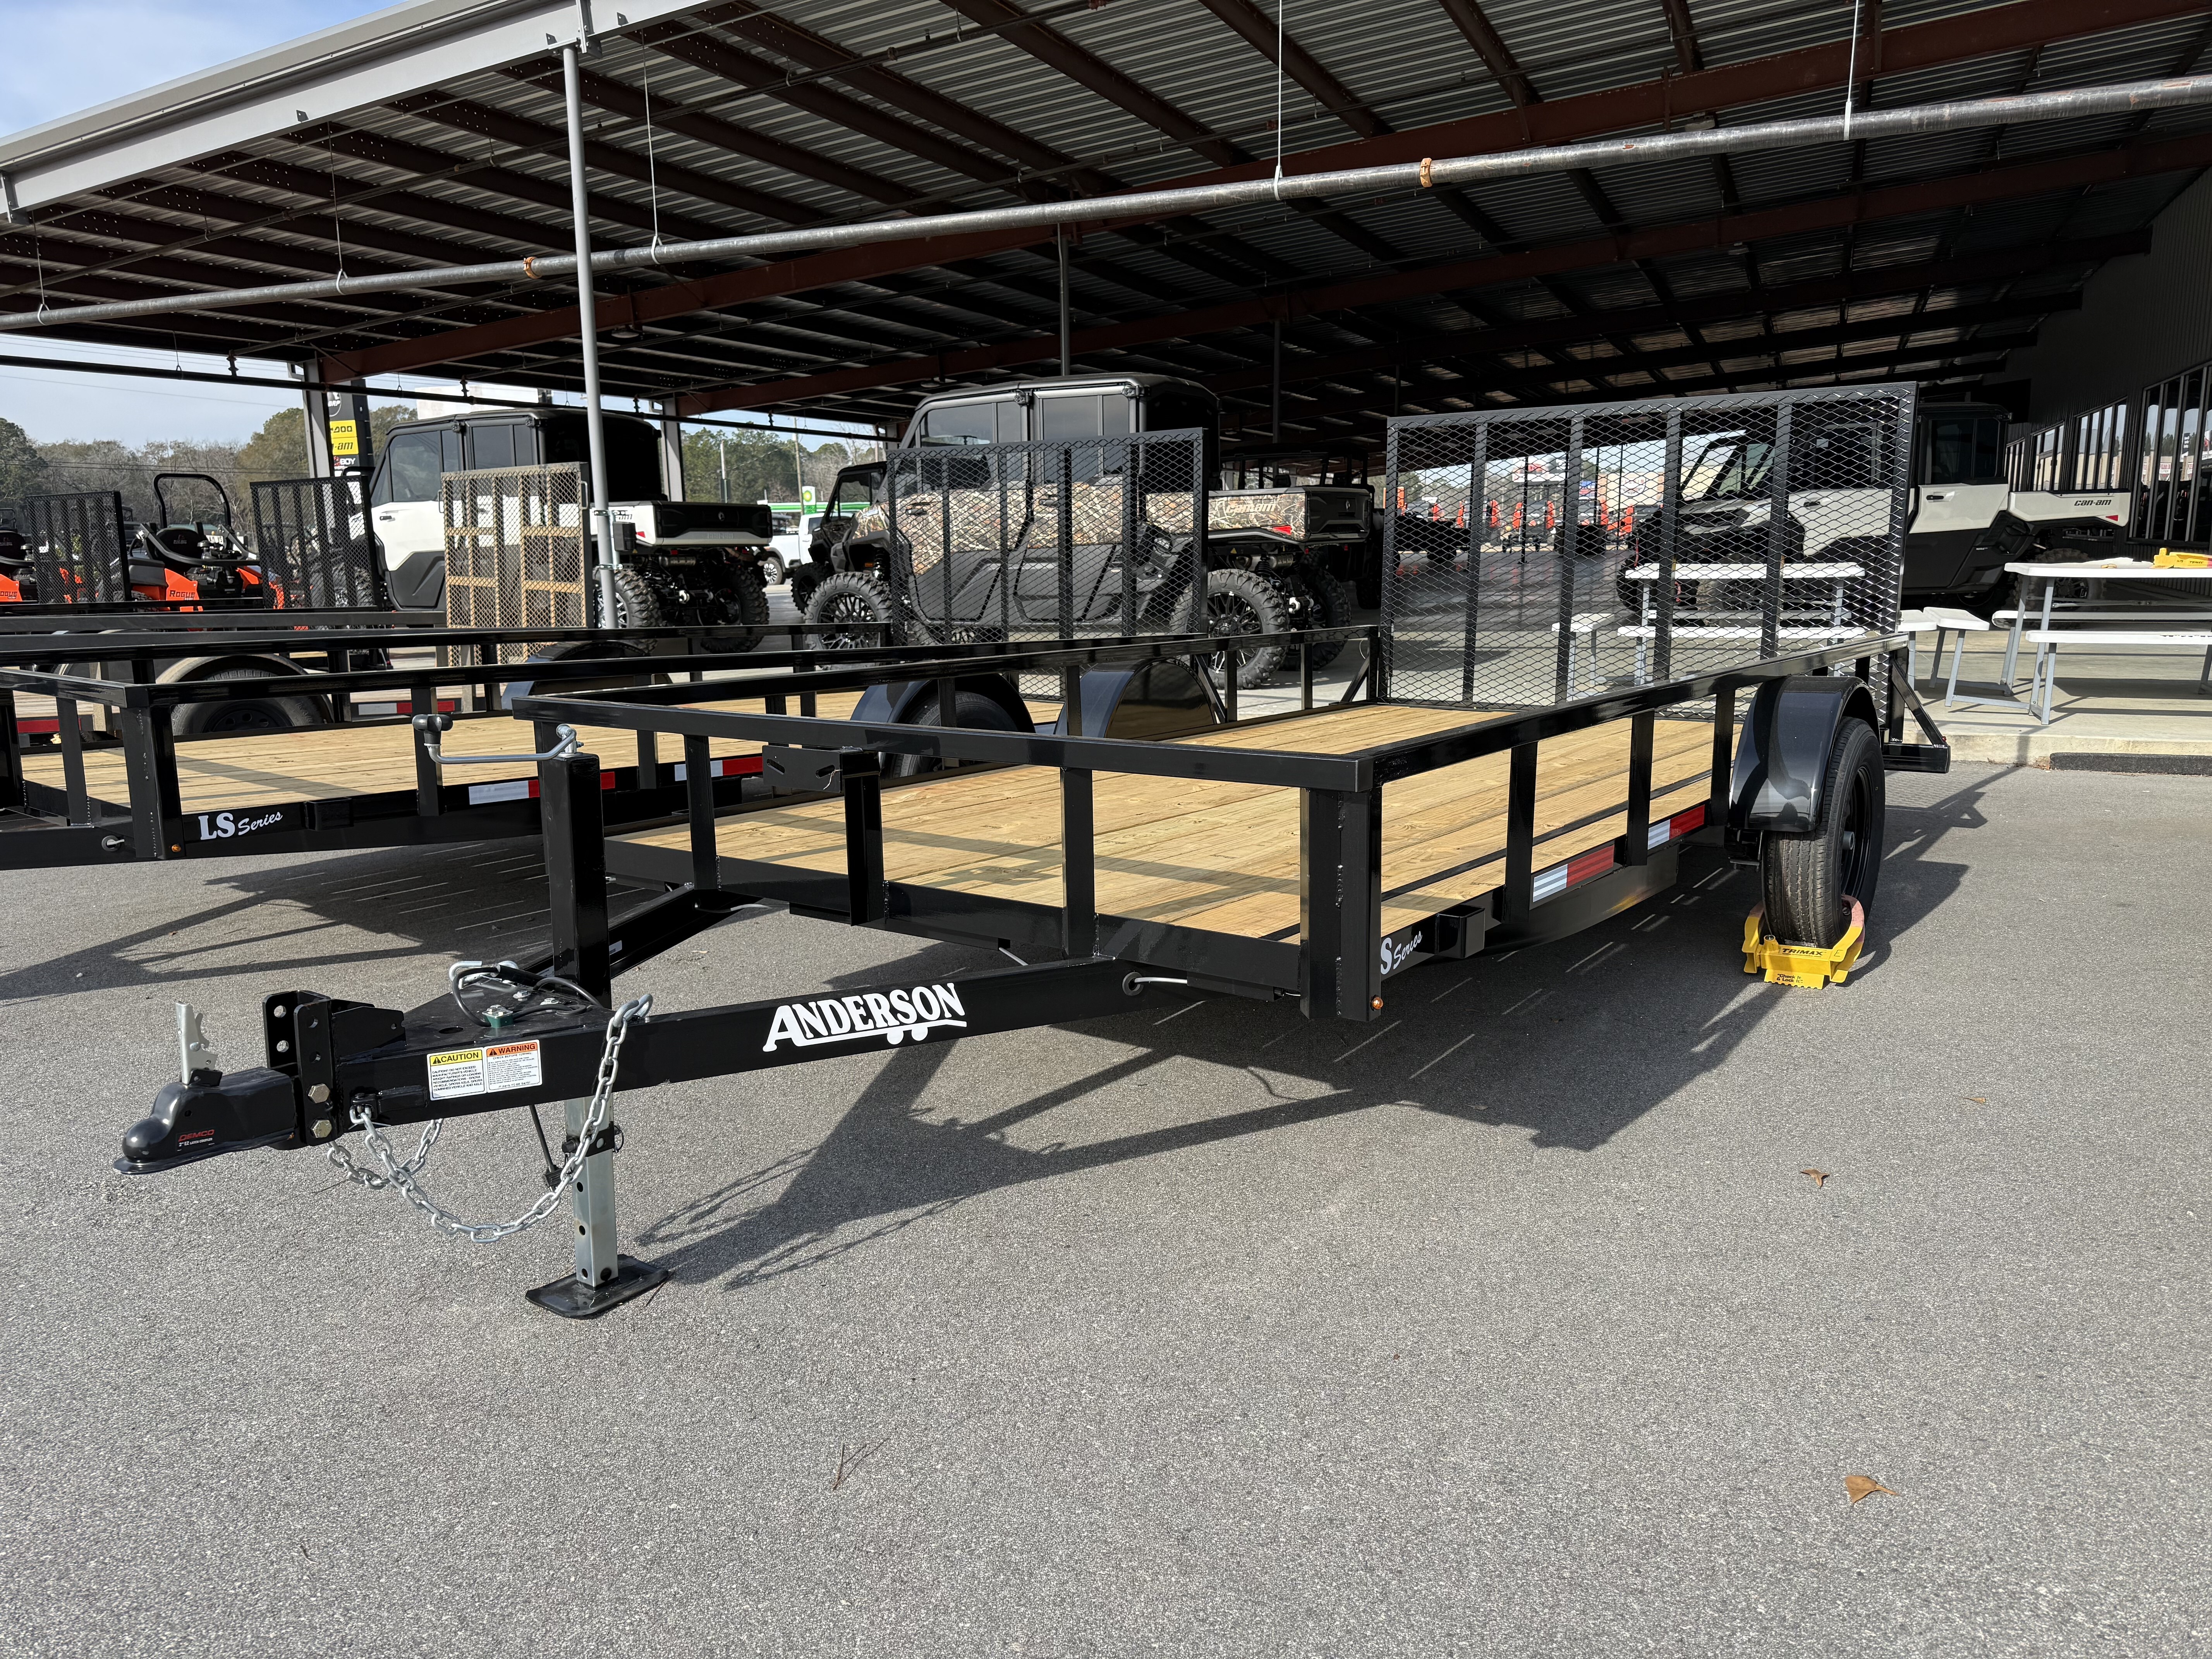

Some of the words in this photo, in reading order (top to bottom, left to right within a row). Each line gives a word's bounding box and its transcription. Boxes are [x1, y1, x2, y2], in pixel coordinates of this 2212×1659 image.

[198, 812, 235, 840] LS
[238, 812, 283, 836] Series
[1381, 937, 1392, 975] S
[1393, 931, 1422, 970] Series
[763, 982, 965, 1052] ANDERSON
[441, 1052, 479, 1063] CAUTION
[498, 1044, 536, 1054] WARNING
[178, 1129, 215, 1142] DEMCO
